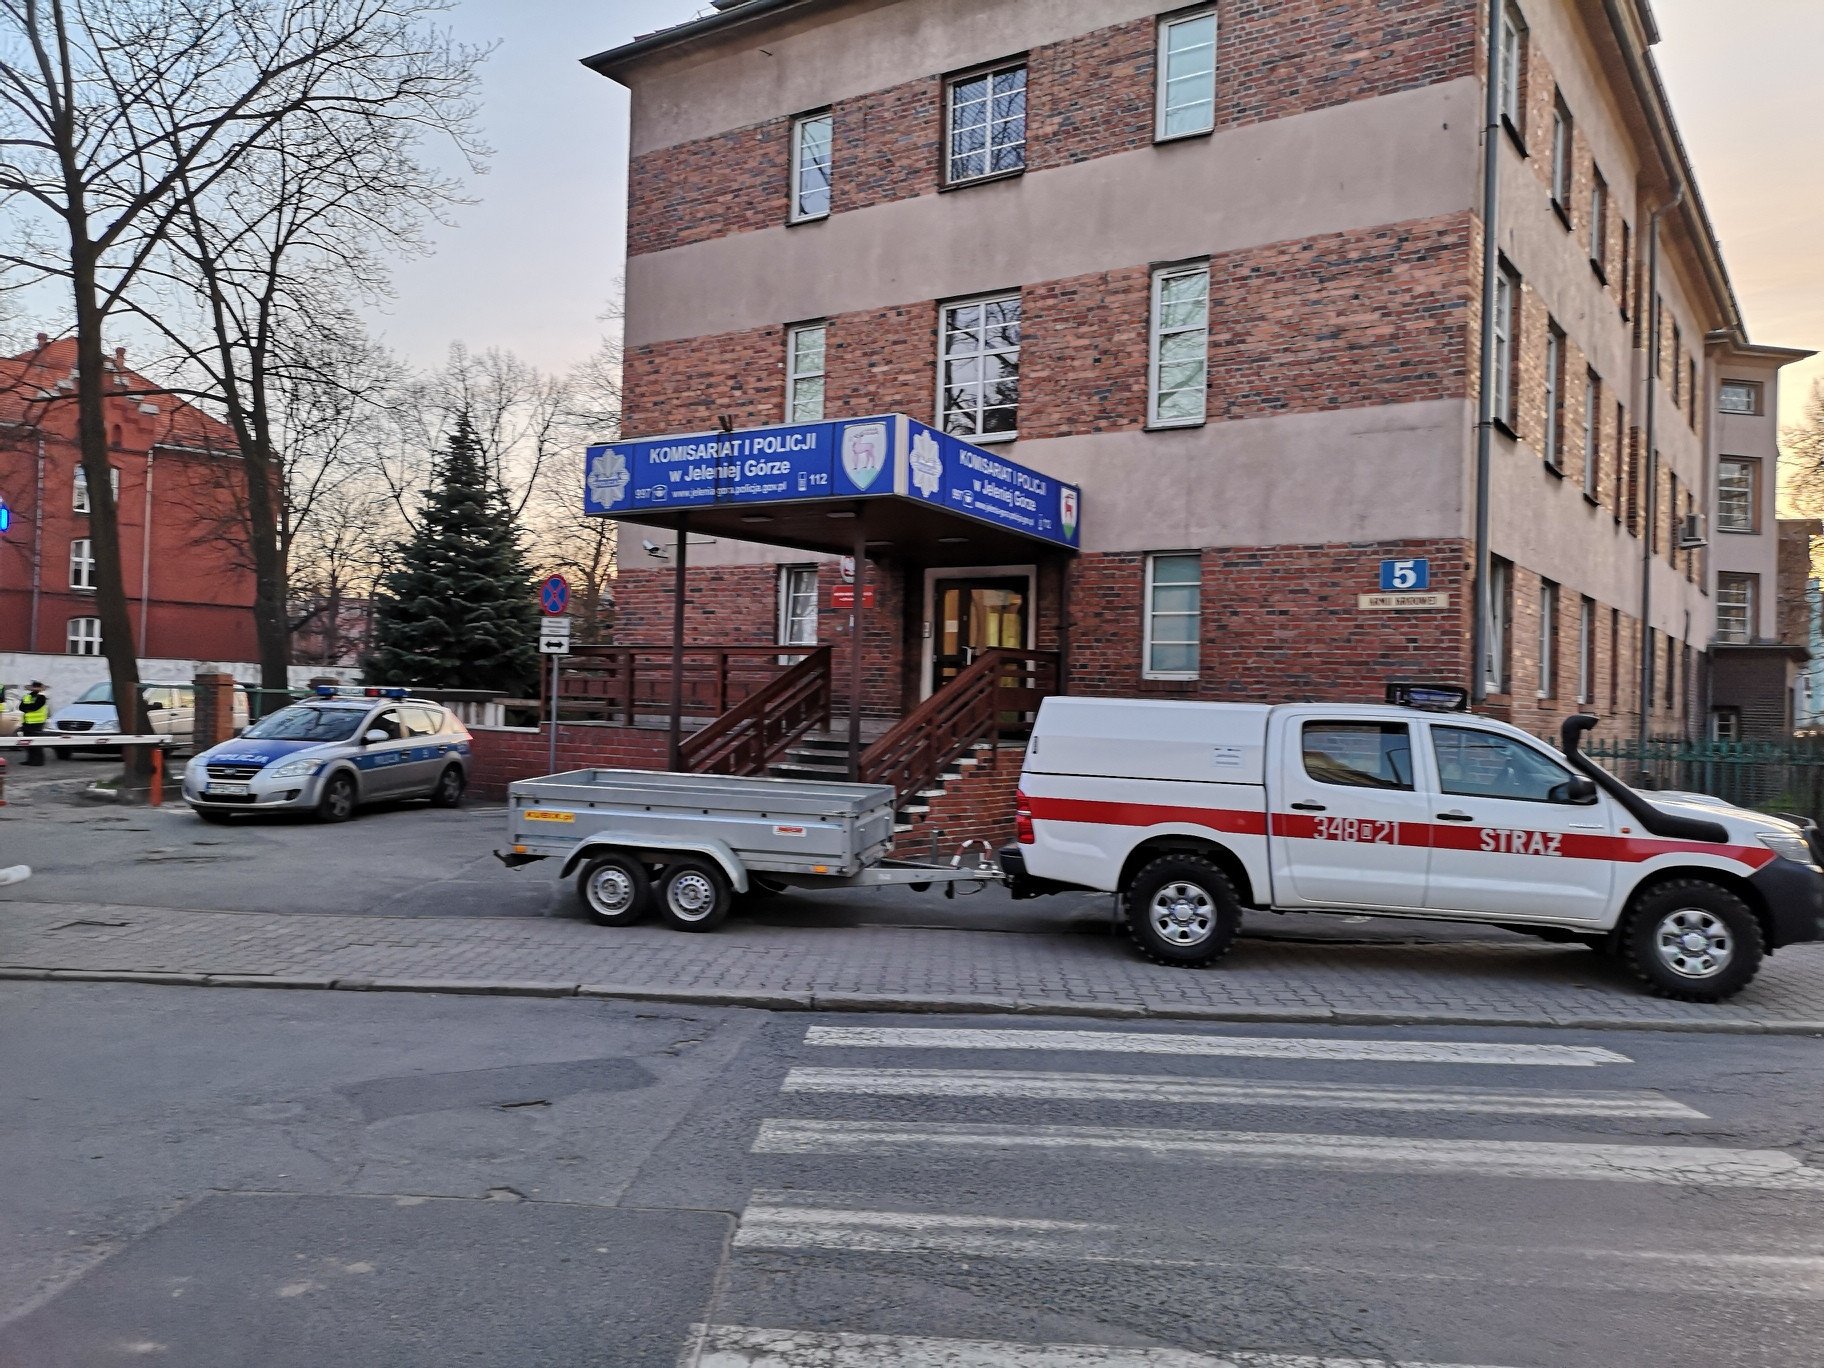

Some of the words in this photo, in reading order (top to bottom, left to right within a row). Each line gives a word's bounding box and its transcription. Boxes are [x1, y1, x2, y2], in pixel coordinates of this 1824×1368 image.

[649, 439, 740, 464] KOMISARIAT
[744, 440, 750, 456] I
[752, 433, 817, 454] POLICJI
[669, 470, 682, 483] w
[684, 461, 741, 482] Jeleniej
[744, 458, 791, 476] Górze
[809, 473, 828, 486] 112
[959, 449, 1013, 483] KOMISARIAT
[1017, 472, 1047, 496] POLICJI
[982, 479, 1013, 507] Jeleniej
[1392, 560, 1417, 588] 5
